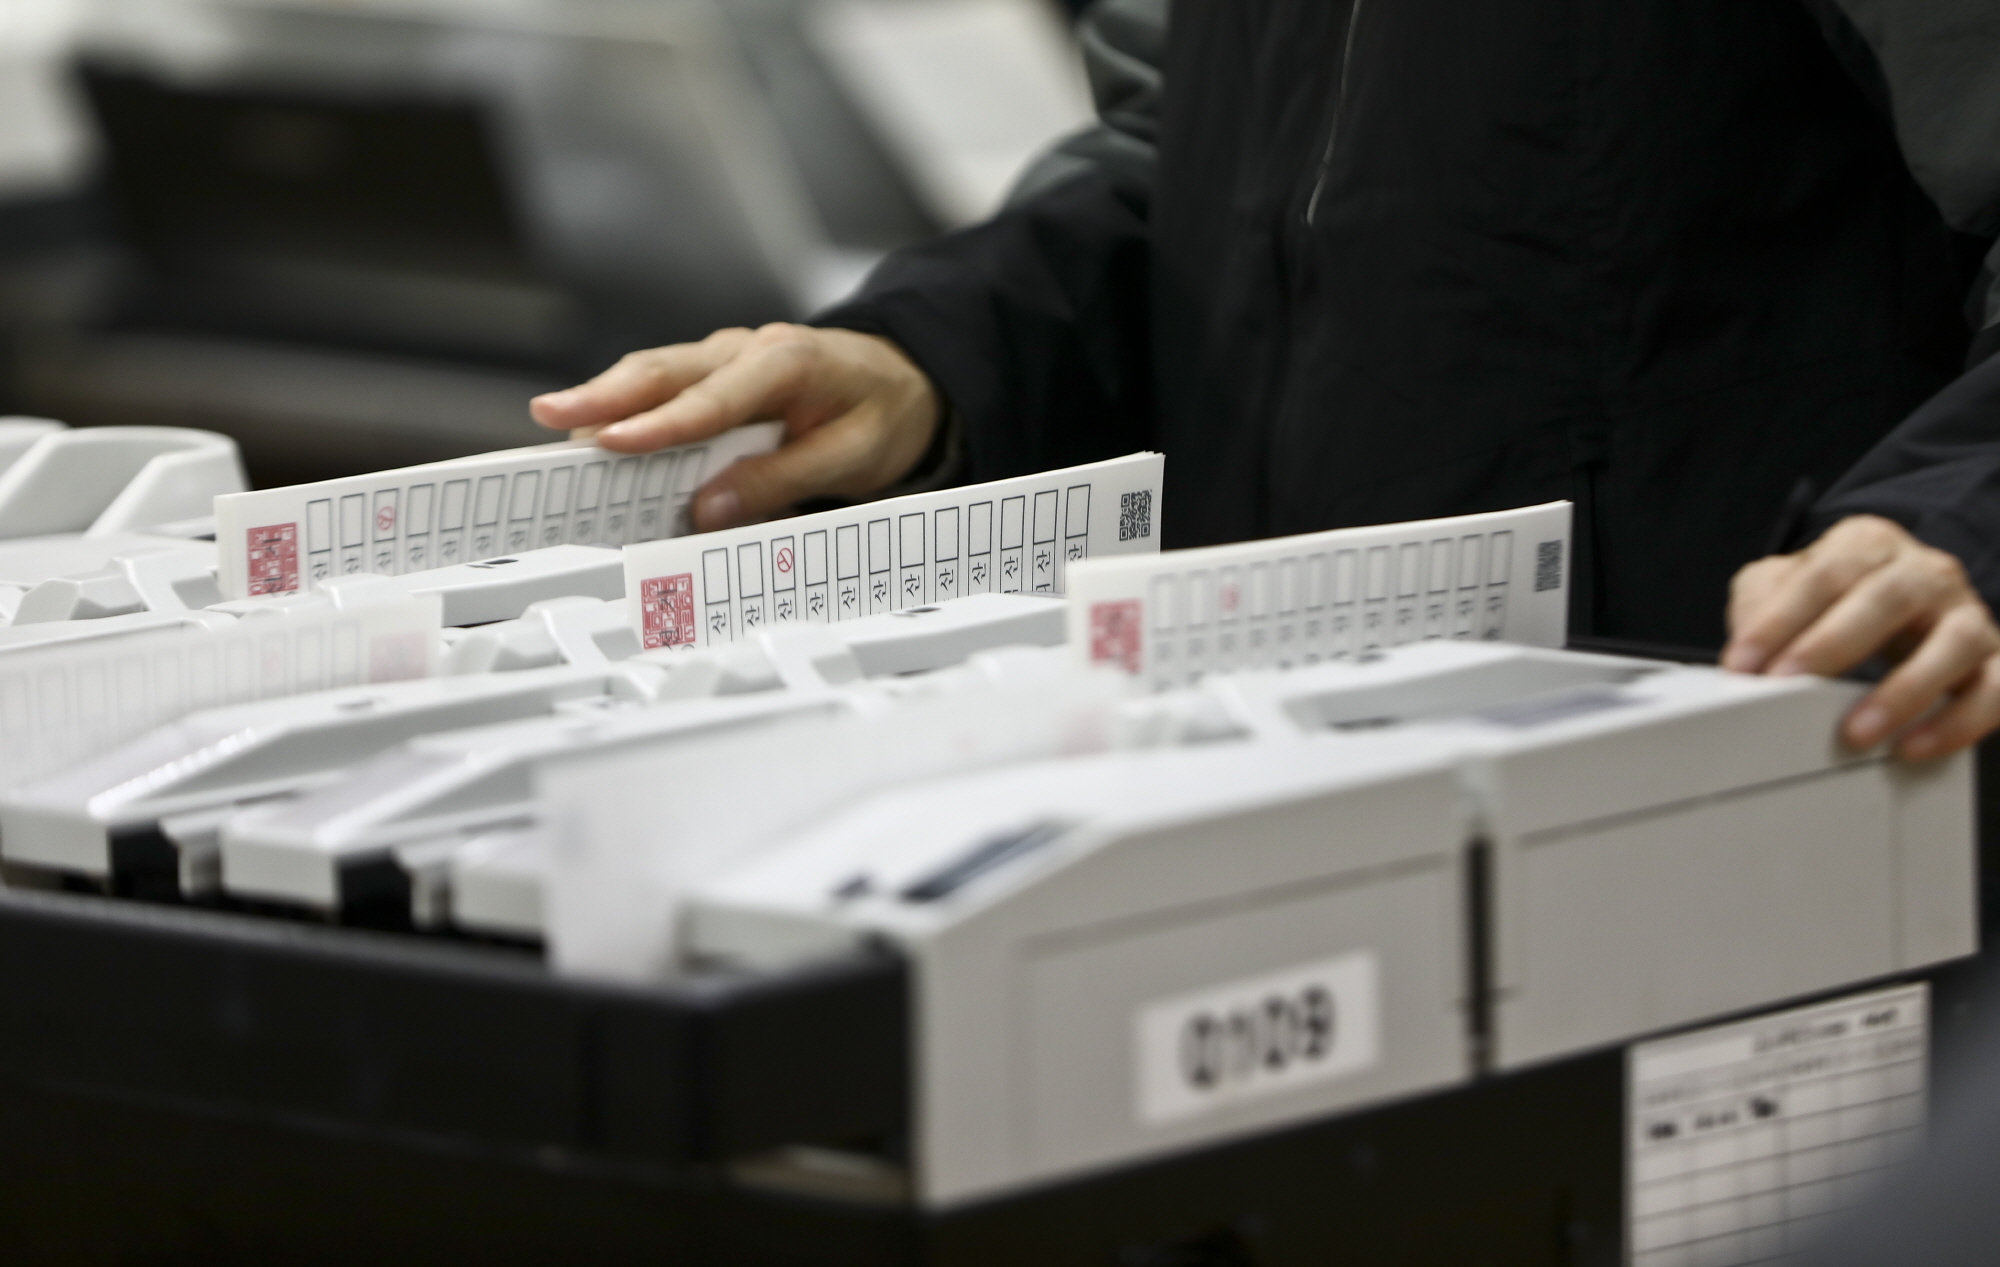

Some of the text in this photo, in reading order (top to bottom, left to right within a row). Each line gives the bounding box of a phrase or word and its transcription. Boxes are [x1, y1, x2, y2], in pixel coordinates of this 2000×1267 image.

[1004, 556, 1019, 579] 산
[1036, 550, 1051, 573] 산
[939, 568, 954, 591] 산
[972, 562, 987, 585] 산
[873, 580, 888, 603] 산
[905, 574, 920, 597] 산
[778, 598, 793, 620] 산
[810, 592, 825, 615] 산
[841, 586, 856, 609] 산
[710, 611, 726, 634] 산
[745, 605, 760, 627] 산
[1177, 983, 1336, 1091] 0109
